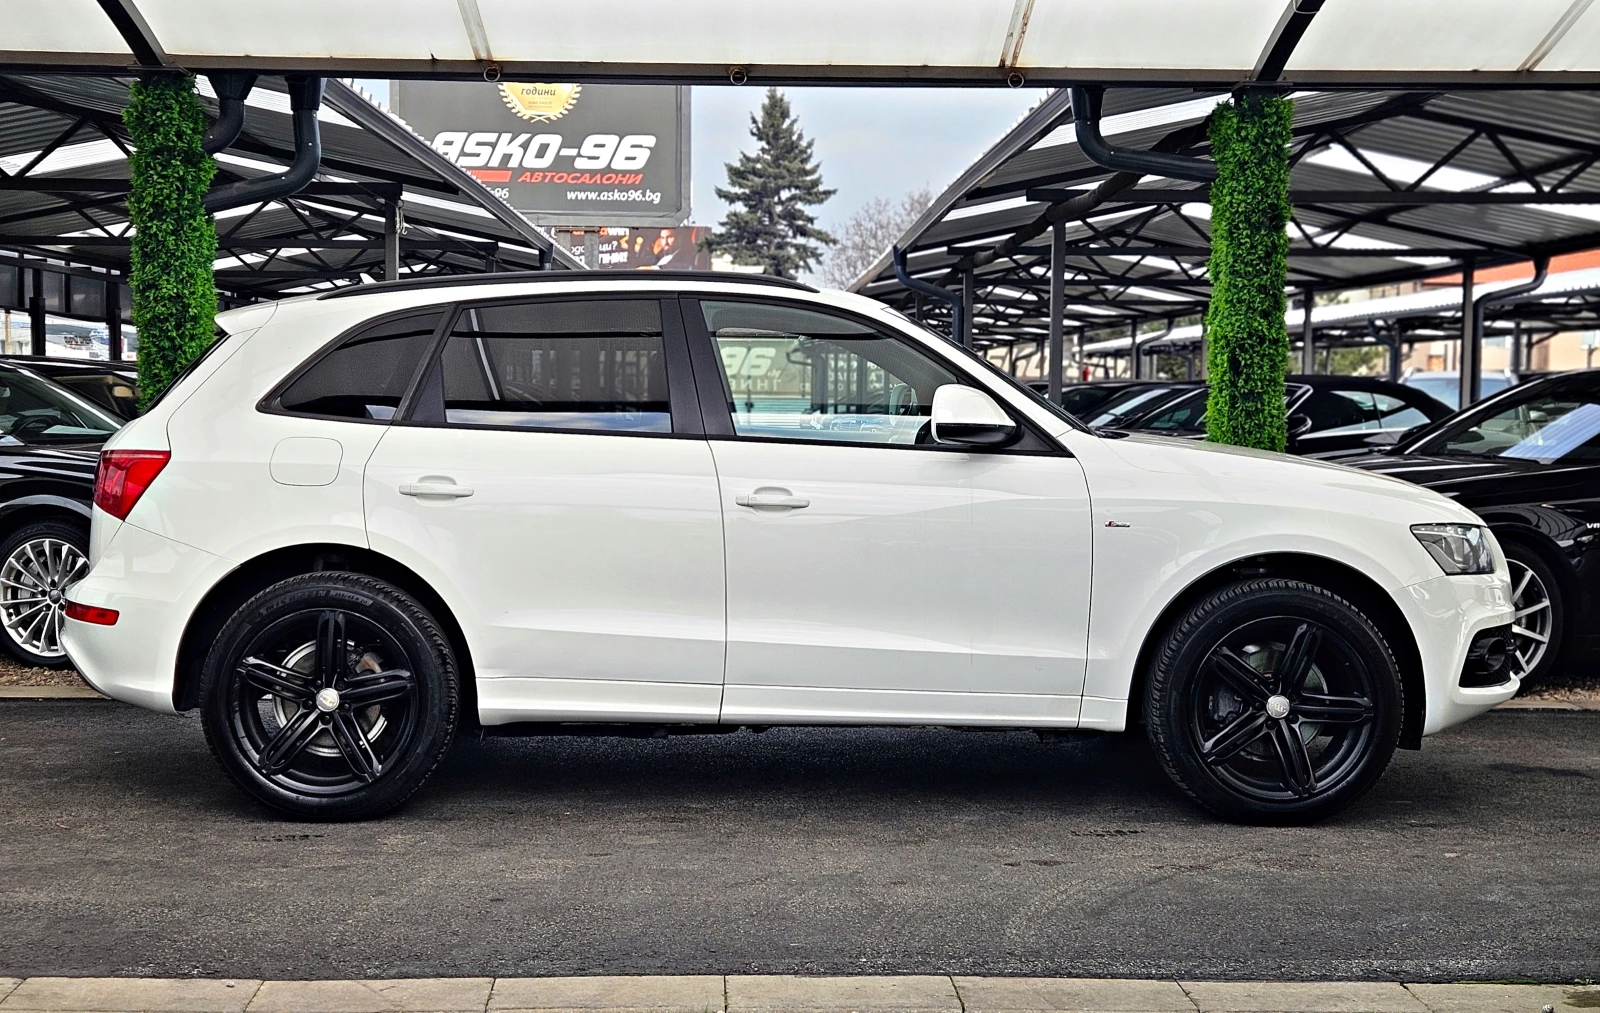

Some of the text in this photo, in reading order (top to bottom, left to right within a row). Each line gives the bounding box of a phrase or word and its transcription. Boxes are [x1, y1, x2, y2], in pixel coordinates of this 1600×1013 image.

[521, 86, 556, 96] години
[431, 131, 657, 170] ASKO-96
[517, 171, 643, 184] АВТОСАЛОНИ
[566, 188, 661, 204] www.asko96.bg
